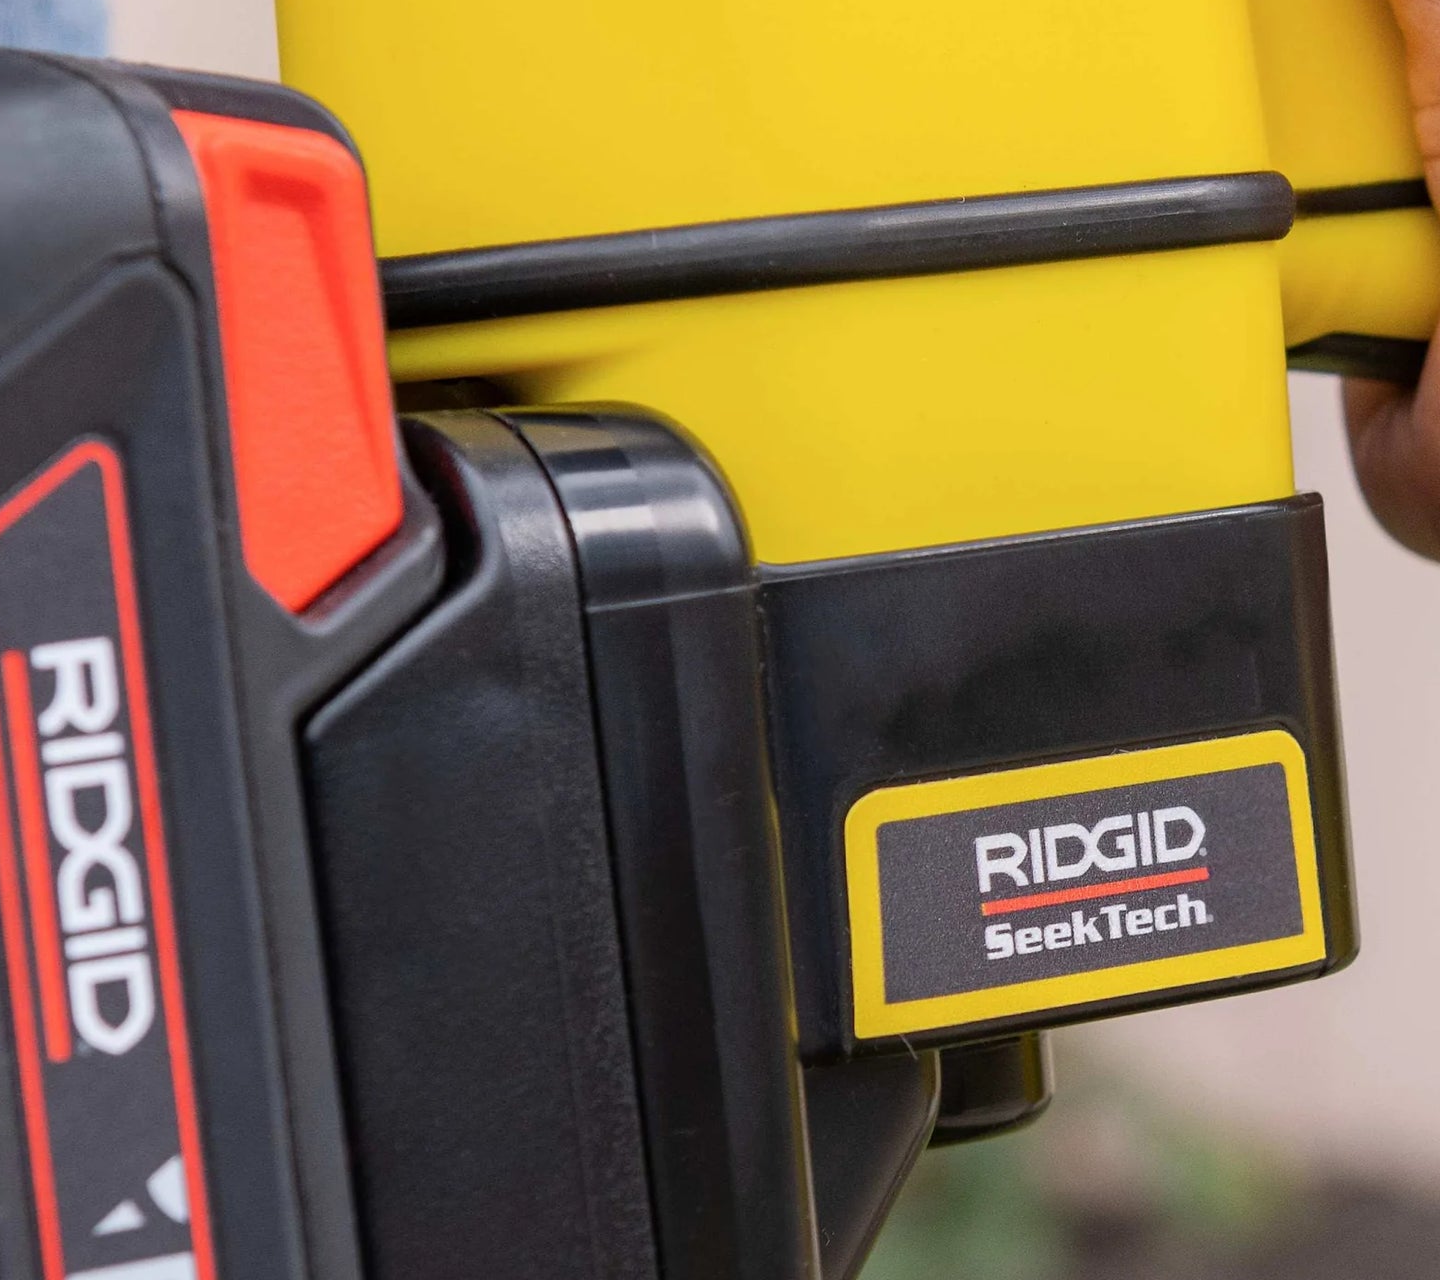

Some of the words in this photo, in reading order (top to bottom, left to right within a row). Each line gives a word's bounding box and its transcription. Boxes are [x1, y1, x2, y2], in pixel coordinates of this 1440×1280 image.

[30, 635, 157, 1057] RIDGID
[975, 805, 1207, 893] RIDGID
[984, 892, 1209, 961] SeekTech
